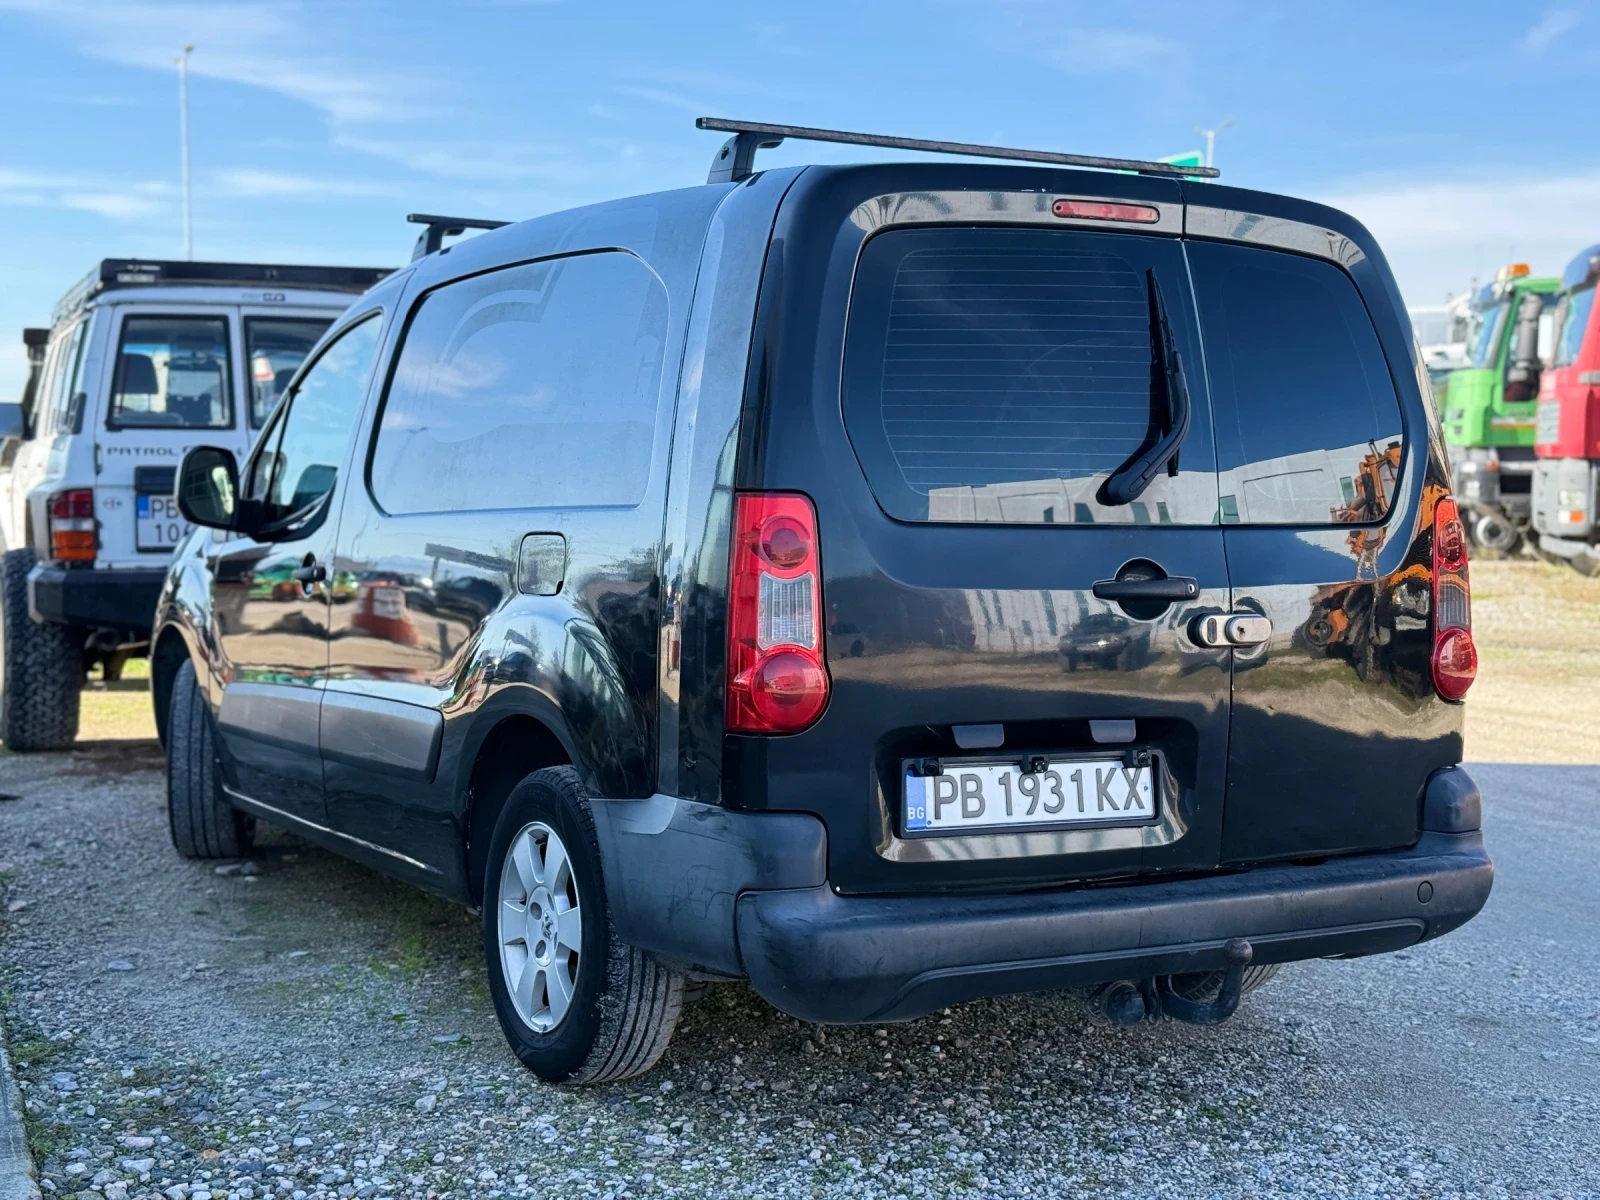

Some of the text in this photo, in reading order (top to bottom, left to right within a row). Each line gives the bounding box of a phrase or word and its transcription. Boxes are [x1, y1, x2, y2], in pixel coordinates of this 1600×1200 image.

[106, 446, 179, 456] PATROL
[151, 499, 179, 519] PB
[934, 767, 1145, 820] PB 1931 KX
[907, 806, 925, 820] BG
